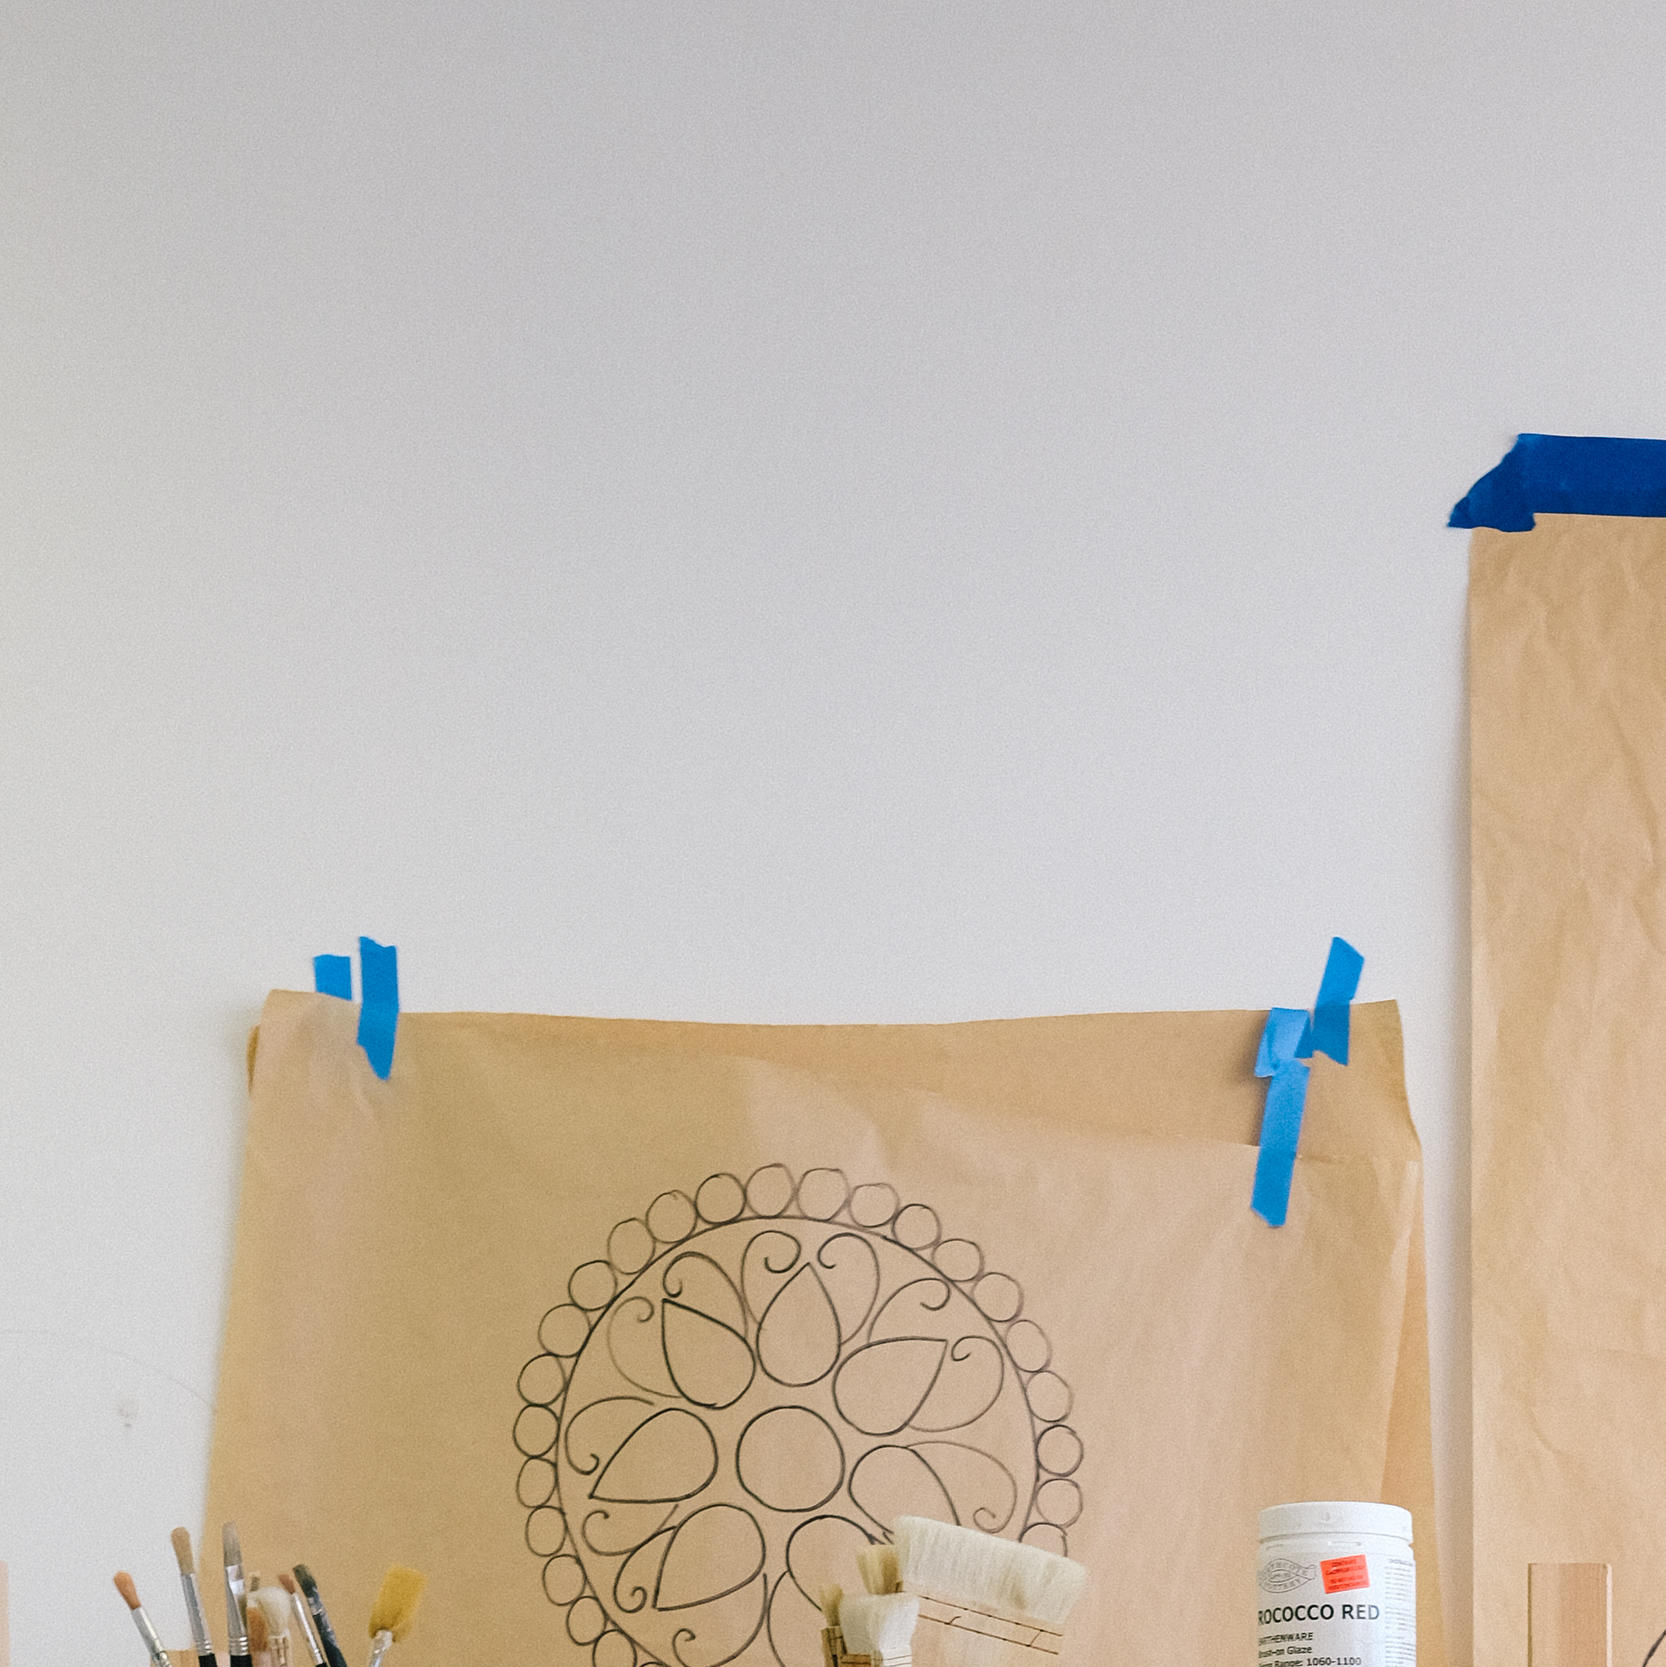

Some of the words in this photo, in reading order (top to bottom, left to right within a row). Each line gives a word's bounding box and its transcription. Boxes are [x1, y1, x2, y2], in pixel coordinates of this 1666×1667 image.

[1342, 1604, 1380, 1620] RED
[1287, 1646, 1313, 1655] Glaze
[1306, 1657, 1362, 1667] 1060-1100
